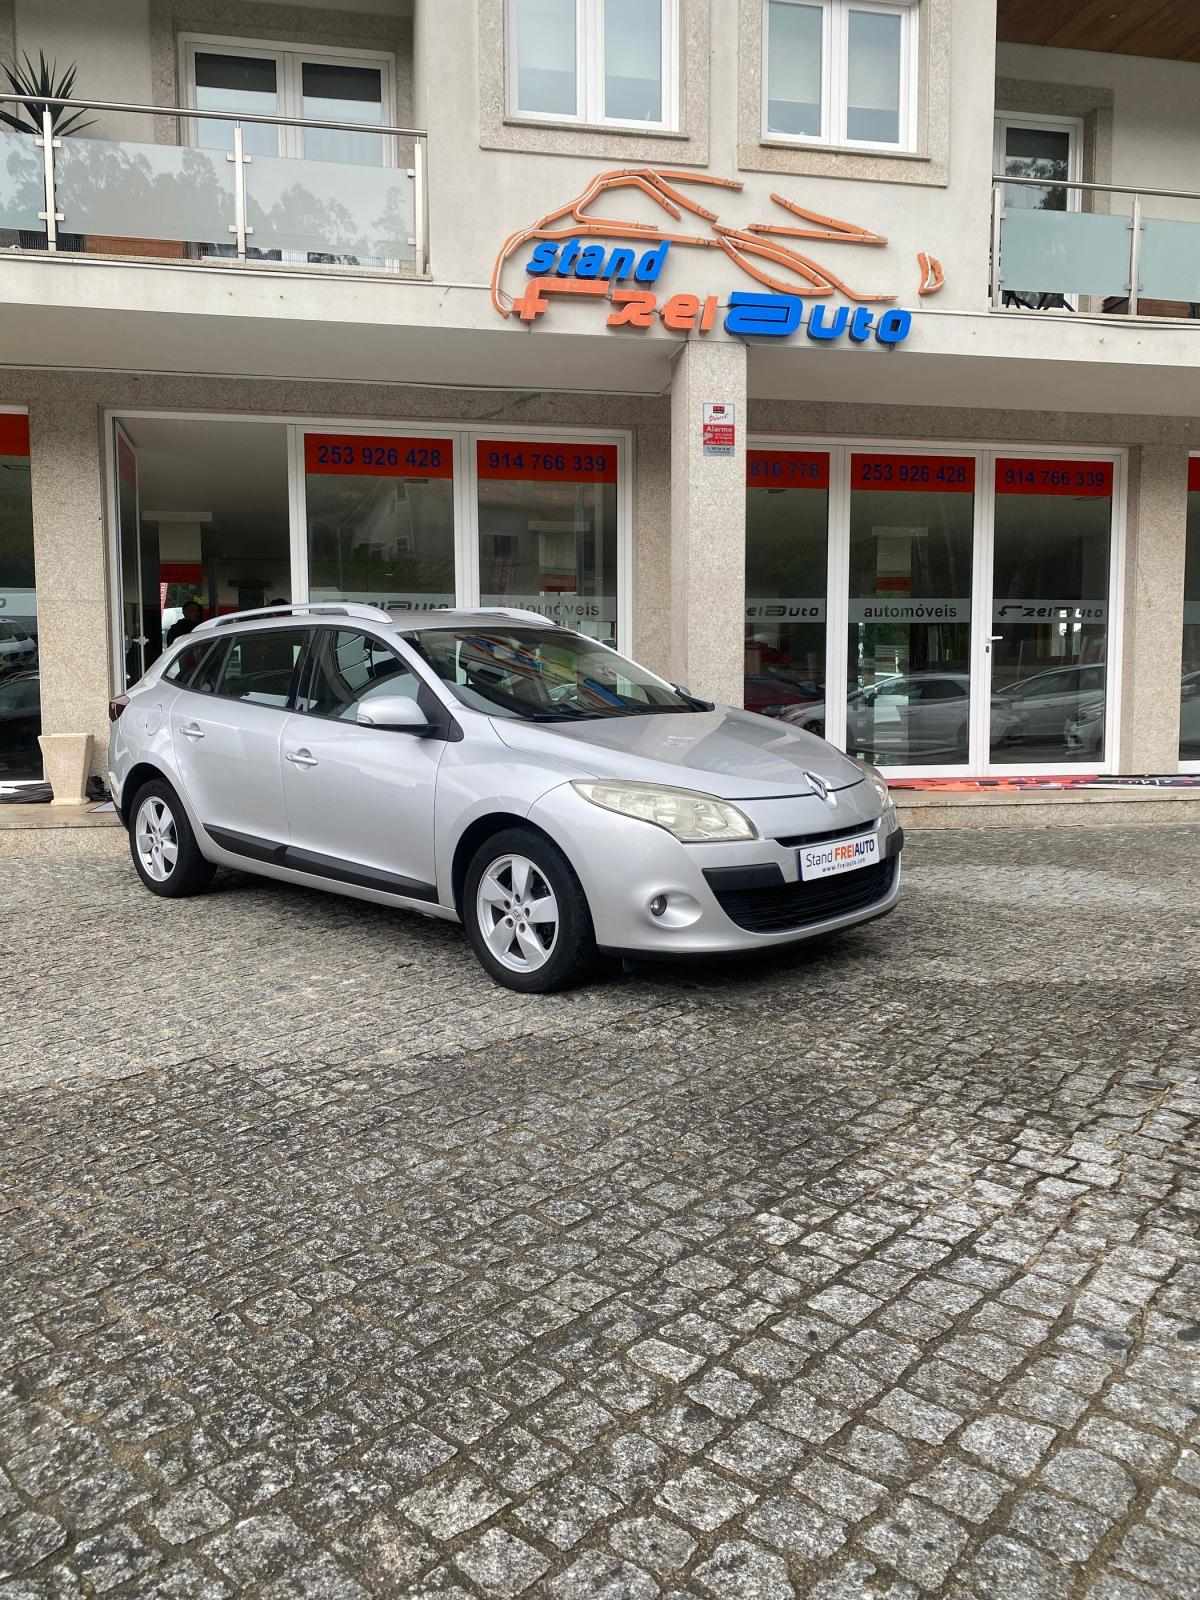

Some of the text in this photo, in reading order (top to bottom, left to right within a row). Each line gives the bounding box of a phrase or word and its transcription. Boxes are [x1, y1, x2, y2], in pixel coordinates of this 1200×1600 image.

[526, 238, 671, 283] stand
[319, 445, 442, 468] 253 926 428
[488, 451, 608, 473] 914 766 339
[863, 463, 967, 483] 253 926 428
[863, 603, 958, 618] automóveis
[806, 839, 875, 868] Stand FREIAUTO
